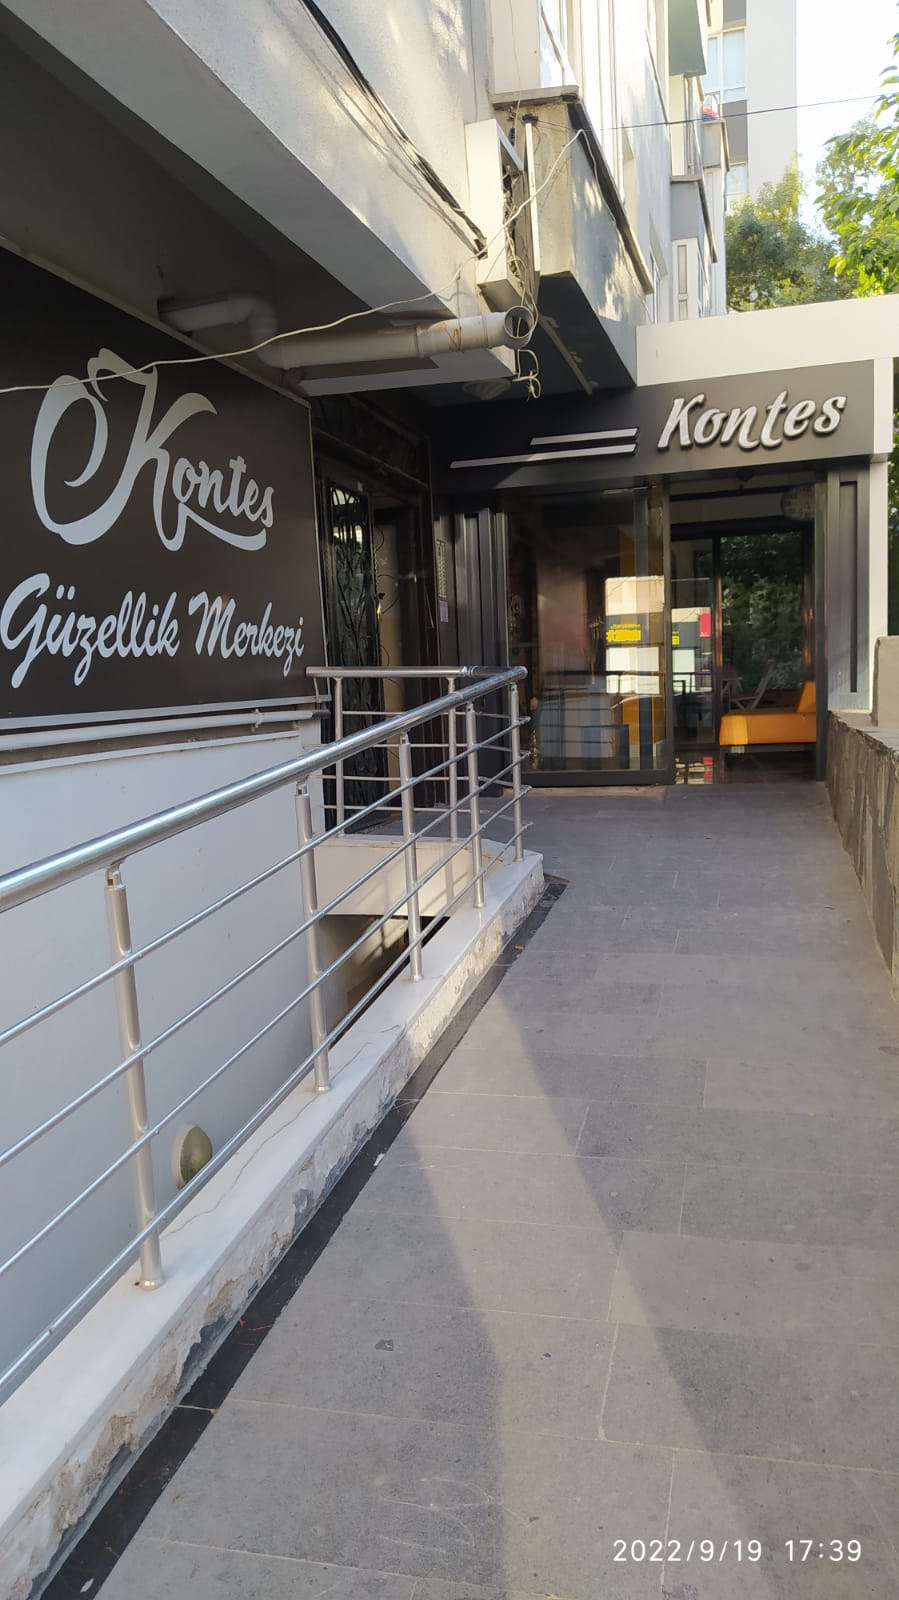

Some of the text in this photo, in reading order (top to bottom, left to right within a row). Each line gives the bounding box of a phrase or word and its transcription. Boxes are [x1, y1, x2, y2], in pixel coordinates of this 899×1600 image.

[31, 348, 274, 552] Kontes
[657, 389, 847, 451] Kontes
[0, 572, 305, 688] Güzellik Merkezi
